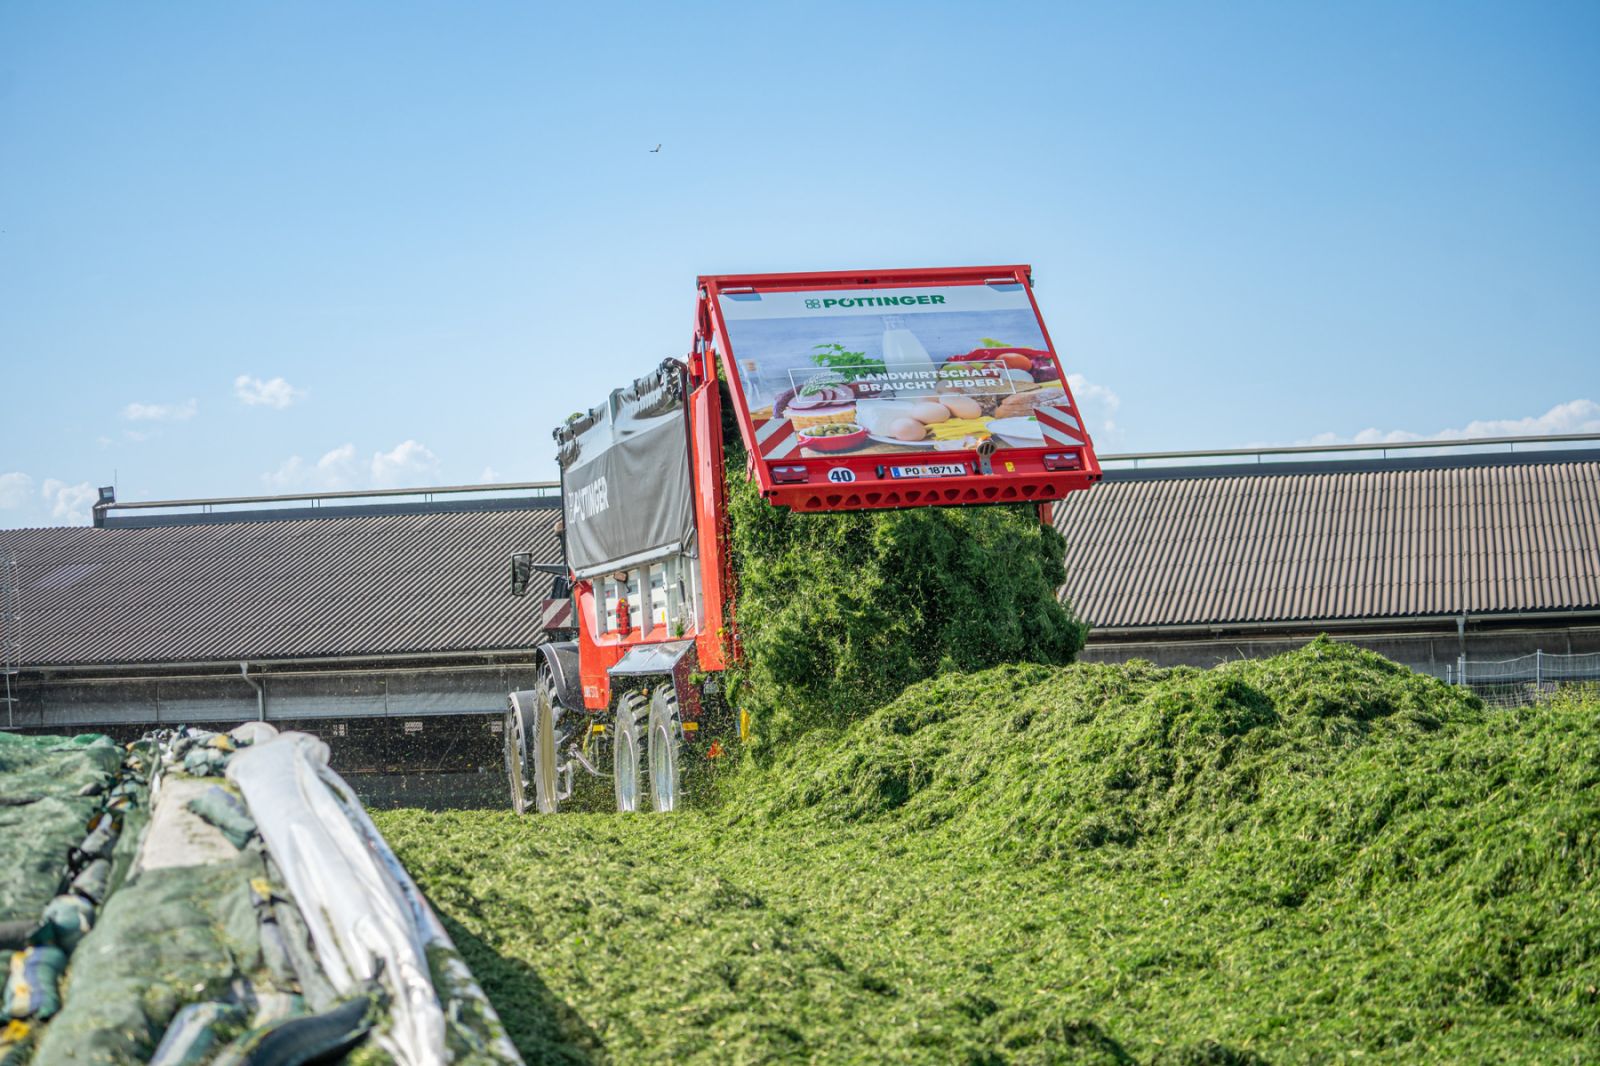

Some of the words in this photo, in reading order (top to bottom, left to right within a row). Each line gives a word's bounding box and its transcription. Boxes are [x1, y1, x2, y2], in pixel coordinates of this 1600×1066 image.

[854, 368, 1000, 382] LANDWIRTSCHAFT
[858, 380, 936, 392] BRAUCHT
[928, 465, 952, 475] 1871
[953, 464, 962, 473] A
[830, 470, 853, 482] 40
